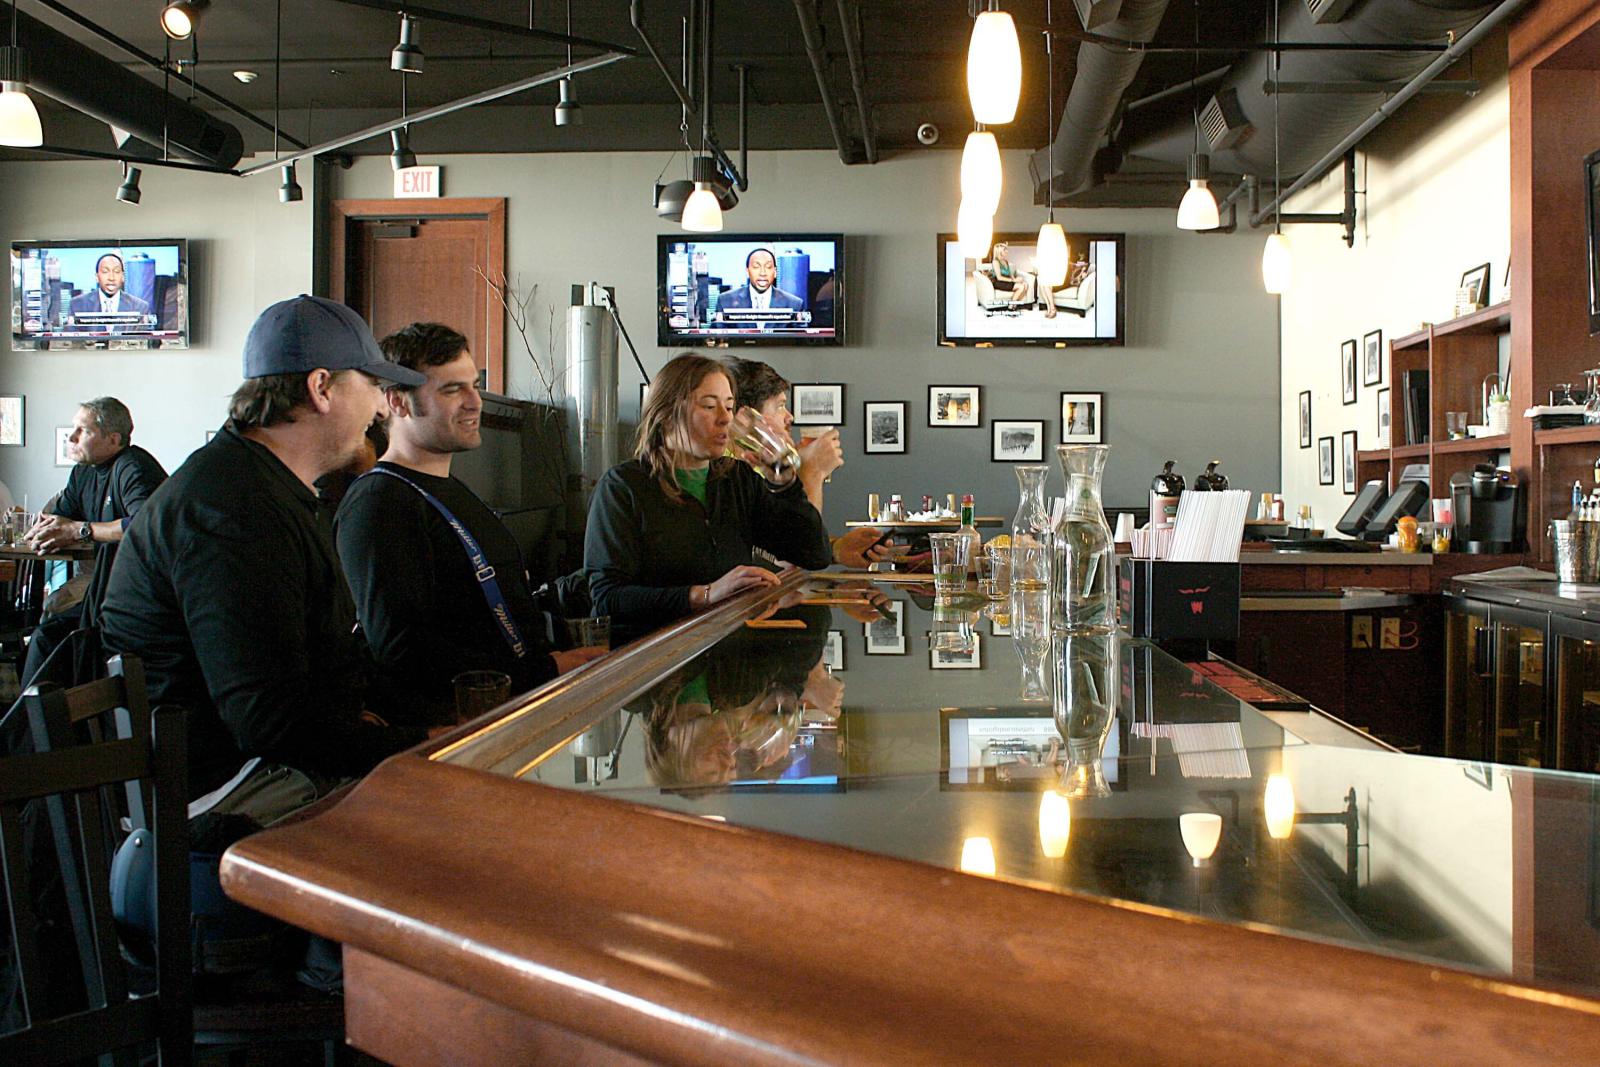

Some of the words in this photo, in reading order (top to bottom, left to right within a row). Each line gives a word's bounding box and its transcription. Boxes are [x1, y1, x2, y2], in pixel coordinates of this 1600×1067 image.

[402, 172, 432, 192] EXIT
[450, 518, 477, 552] Miller
[493, 603, 518, 641] Miller
